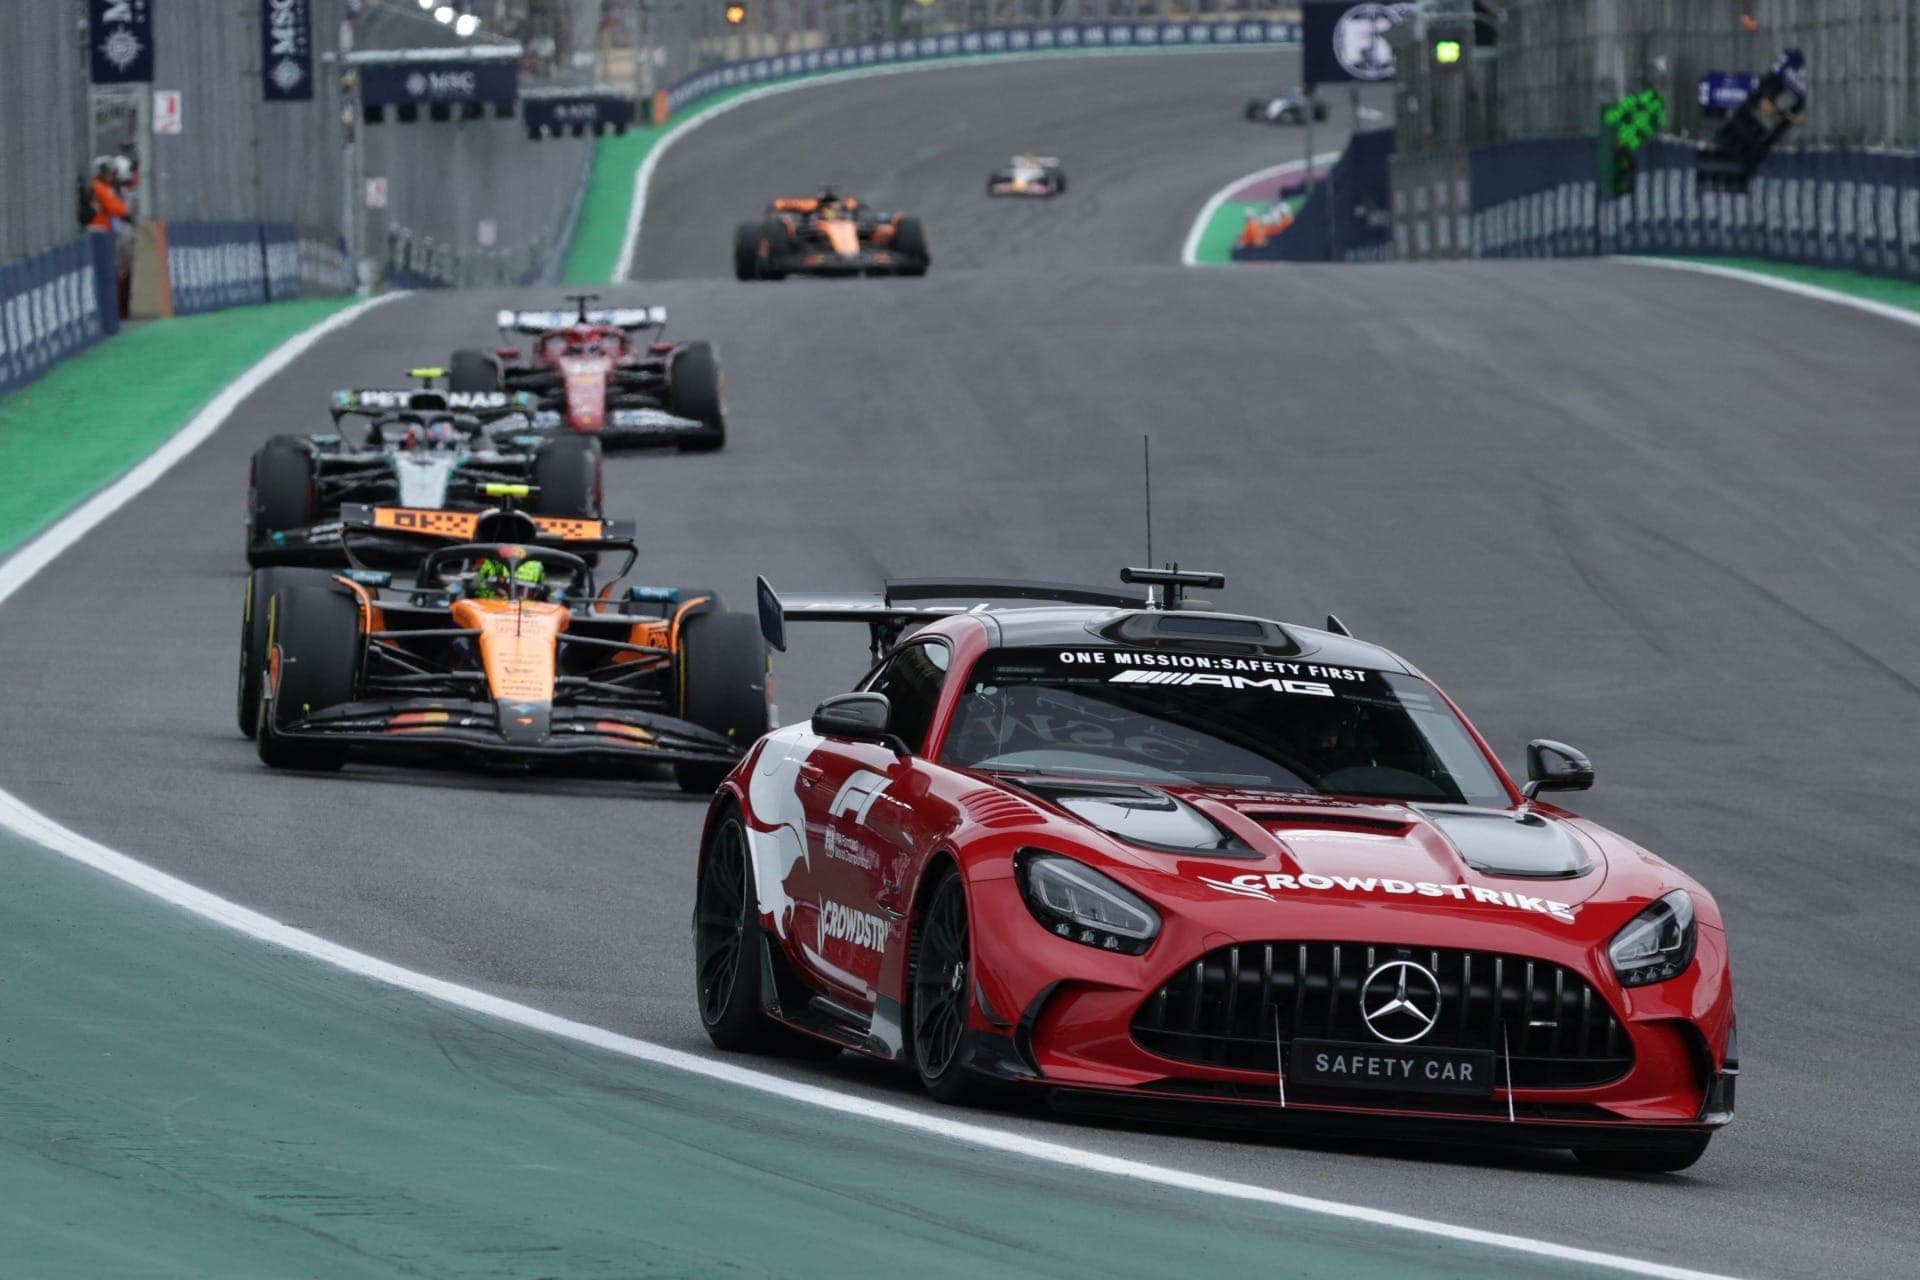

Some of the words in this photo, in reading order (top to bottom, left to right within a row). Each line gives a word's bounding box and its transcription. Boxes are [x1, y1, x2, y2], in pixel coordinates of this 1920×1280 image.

[361, 391, 506, 408] PETNAS
[1059, 651, 1106, 664] ONE
[1308, 665, 1366, 682] FIRST
[1183, 673, 1335, 697] AMG
[1231, 873, 1575, 921] CROWDSTRIKE
[1315, 1053, 1414, 1078] SAFETY
[1425, 1061, 1473, 1081] CAR
